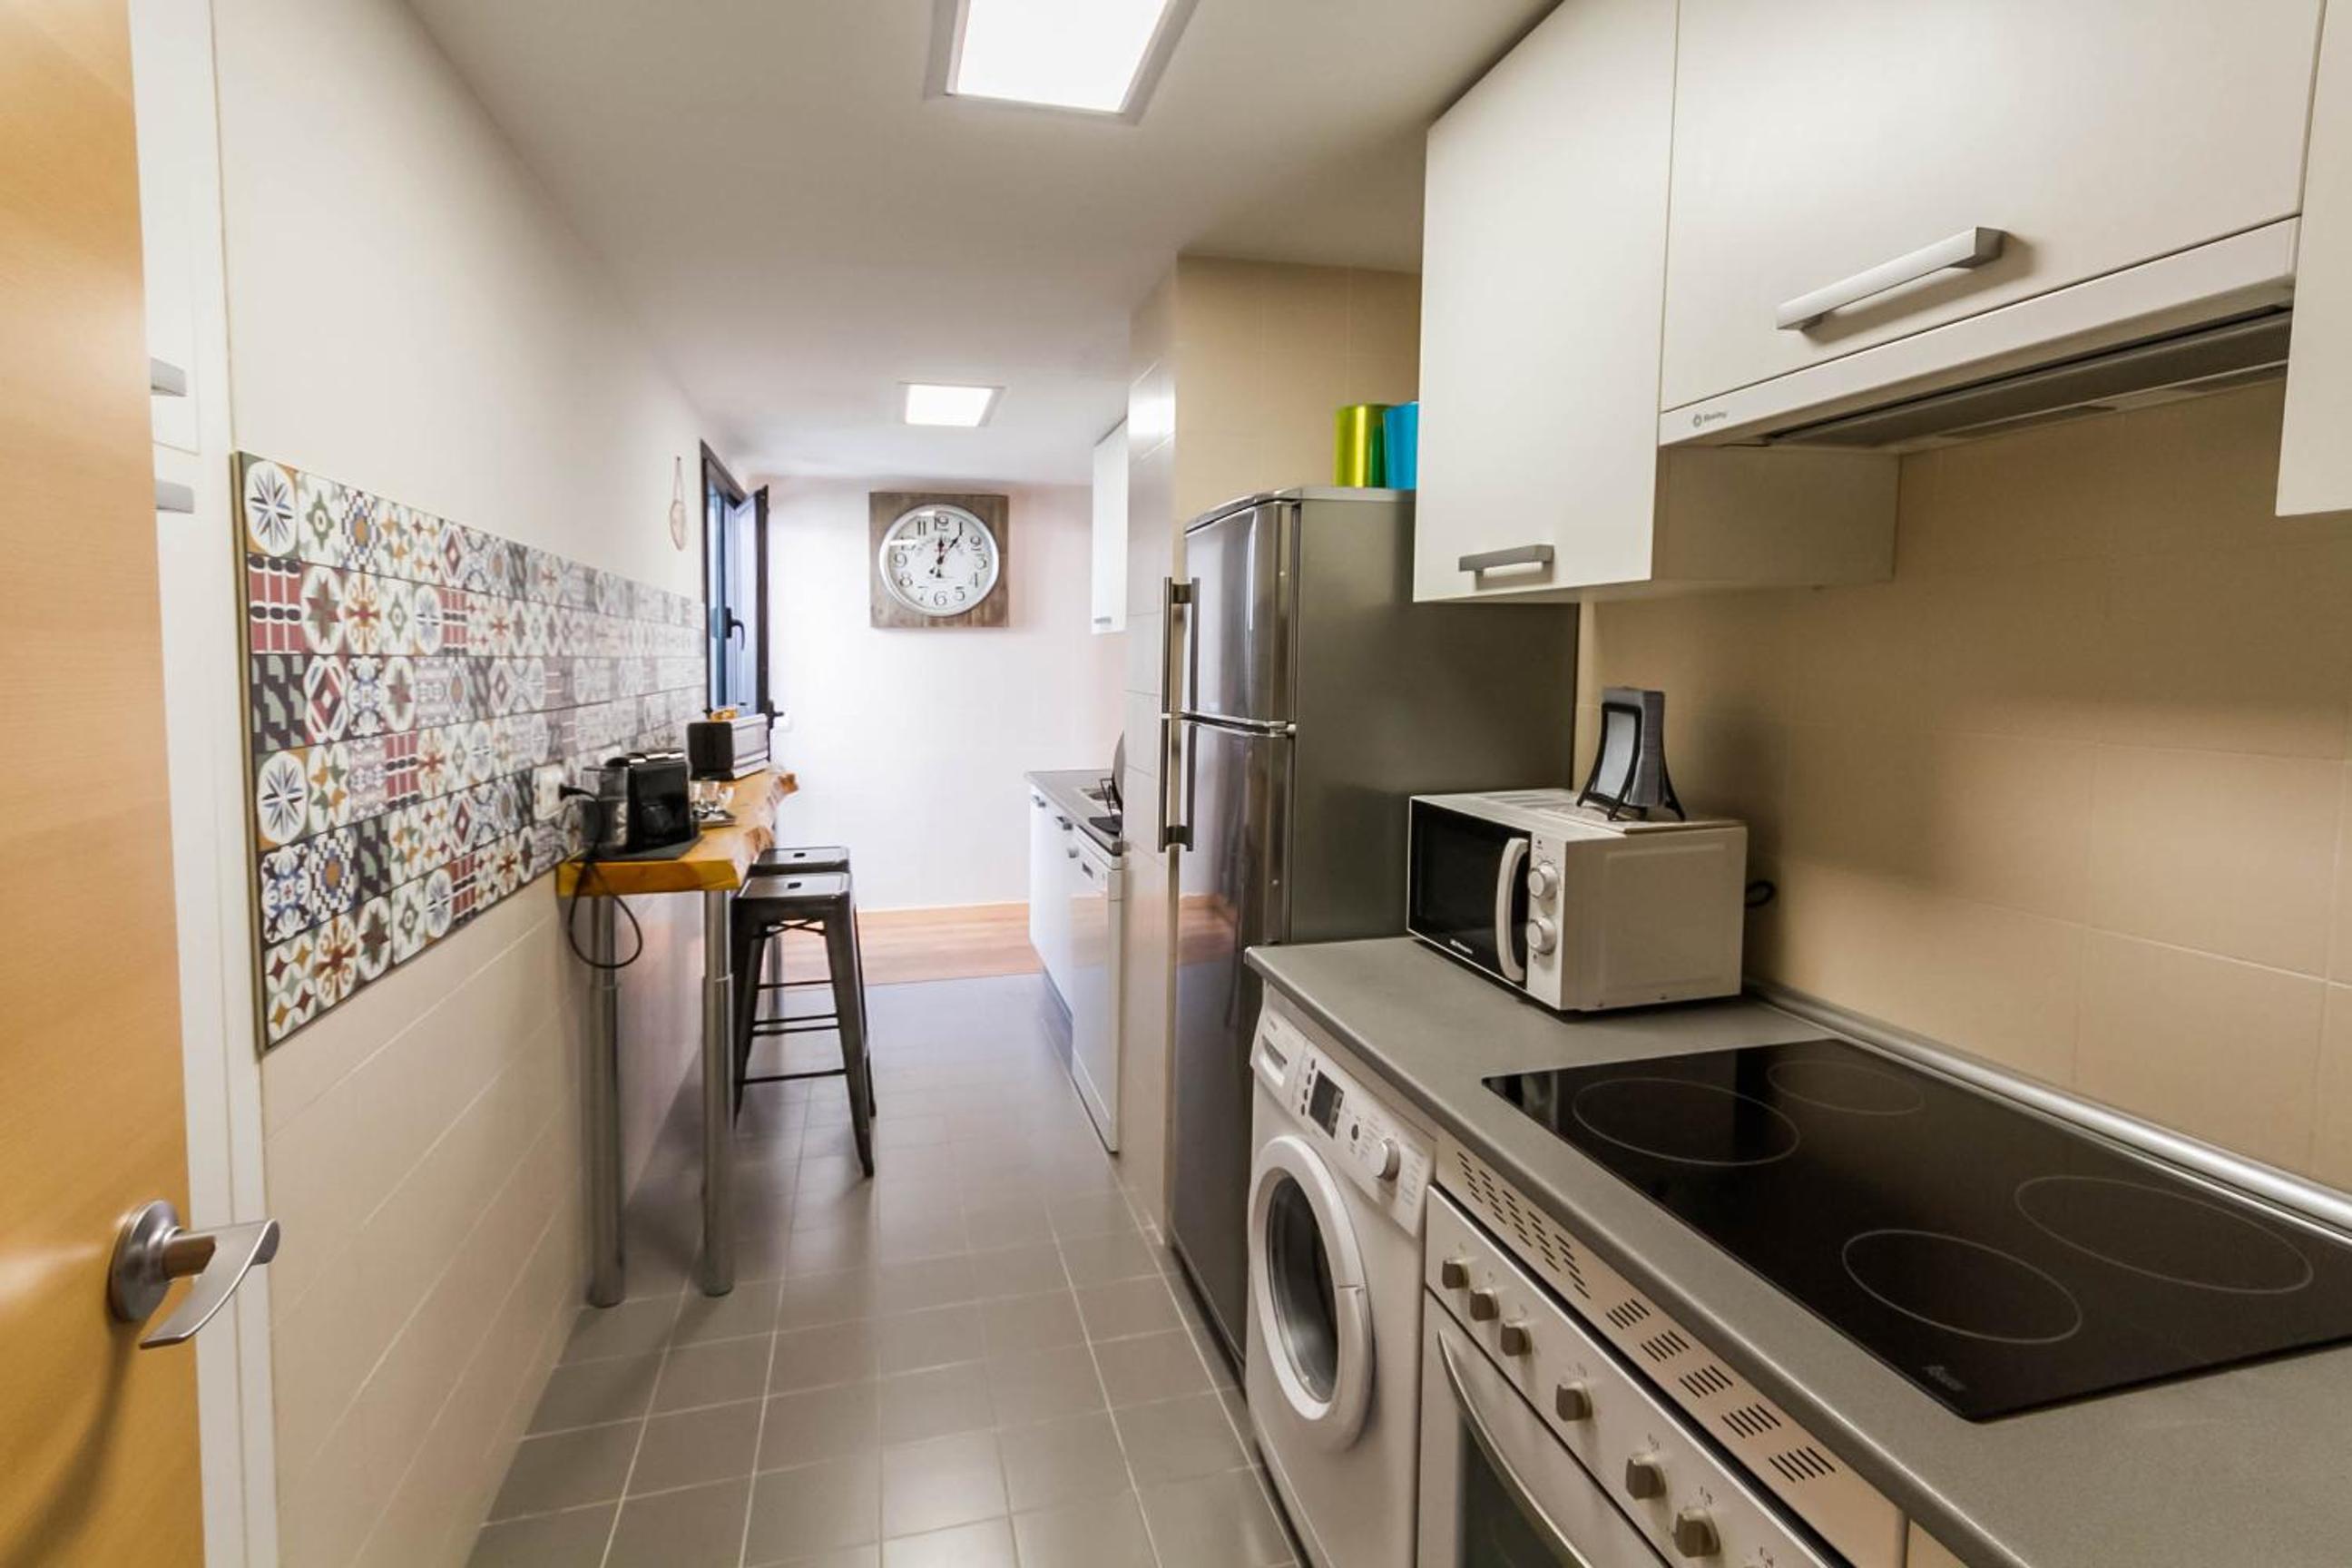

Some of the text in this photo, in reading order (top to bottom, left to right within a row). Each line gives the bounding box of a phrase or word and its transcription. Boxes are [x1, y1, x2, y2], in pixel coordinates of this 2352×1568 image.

[917, 520, 926, 535] 11
[934, 514, 949, 531] 12
[970, 536, 981, 551] 2
[894, 553, 907, 569] 9
[975, 553, 987, 571] 3
[899, 573, 913, 587] 8
[934, 591, 947, 605] 6
[955, 586, 965, 601] 5
